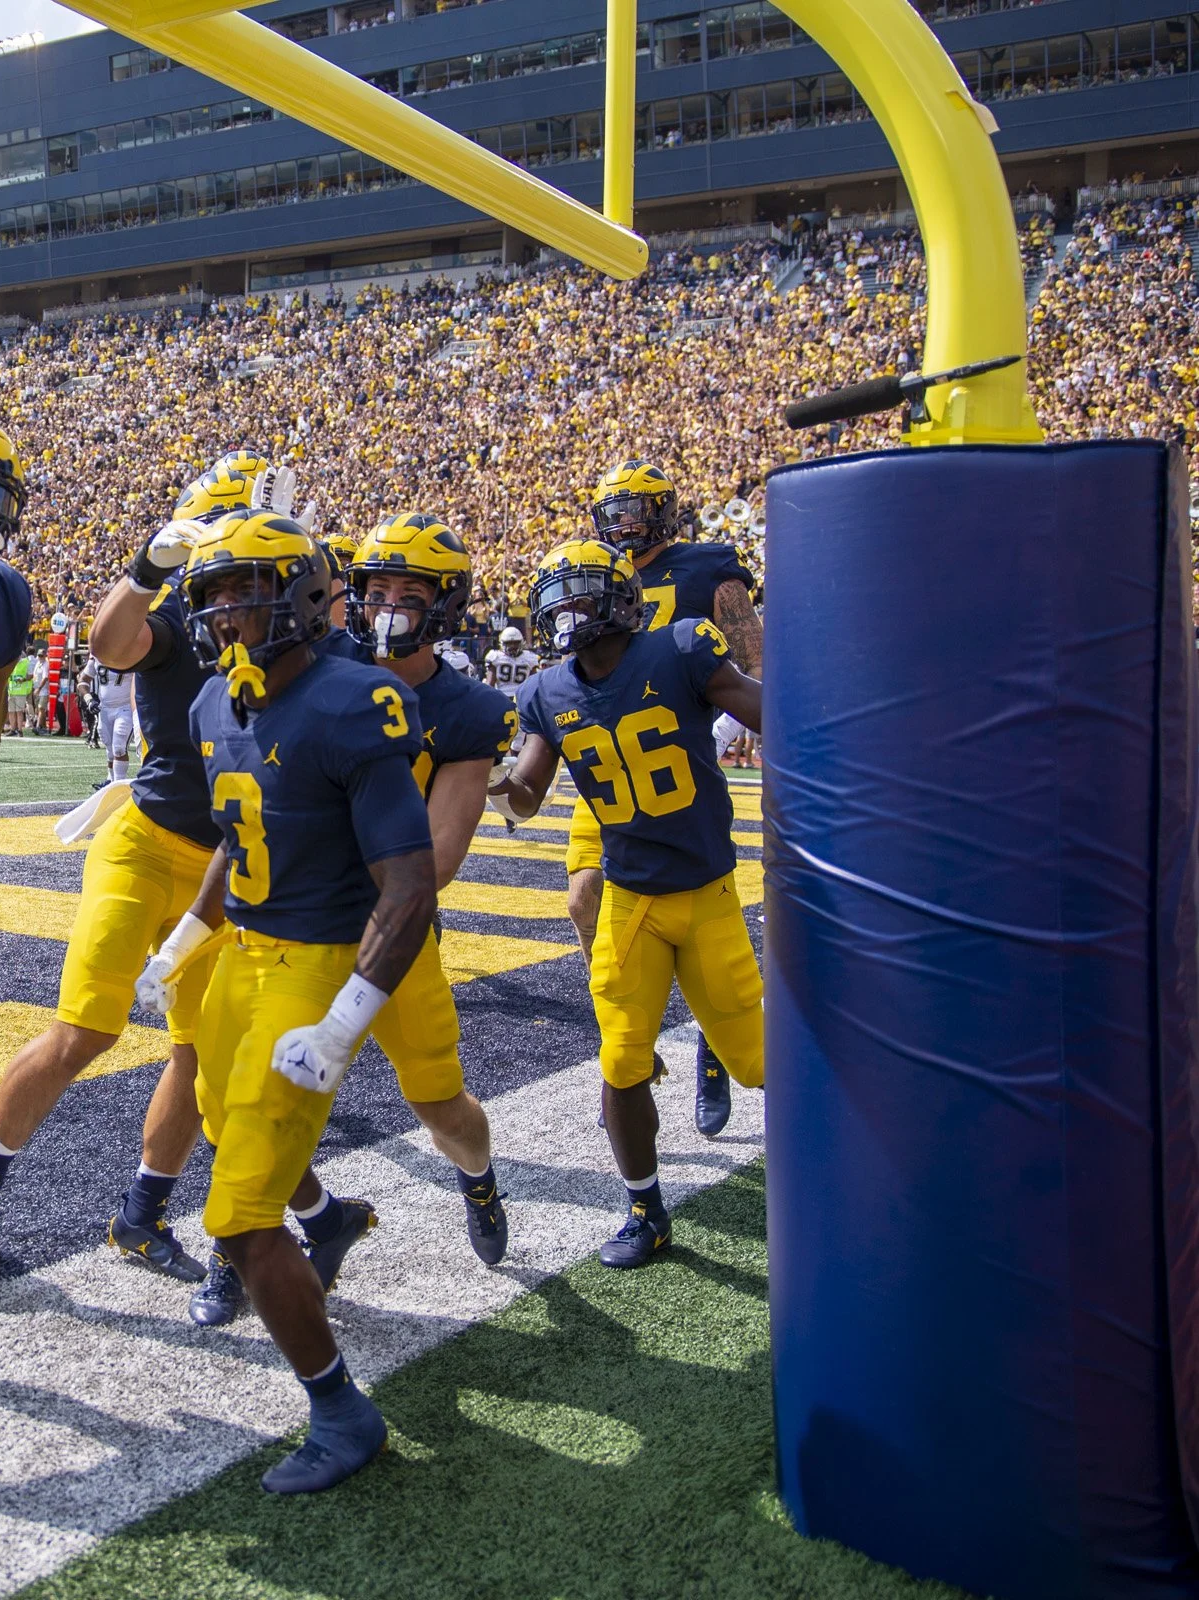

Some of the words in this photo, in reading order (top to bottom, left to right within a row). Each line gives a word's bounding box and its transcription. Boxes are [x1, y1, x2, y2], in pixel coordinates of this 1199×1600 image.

[262, 473, 276, 510] IGAN
[642, 585, 676, 631] 7
[696, 618, 730, 656] 3
[498, 663, 529, 684] 95
[372, 686, 409, 739] 3
[496, 710, 520, 752] 3
[561, 705, 697, 825] 36
[213, 771, 271, 906] 3
